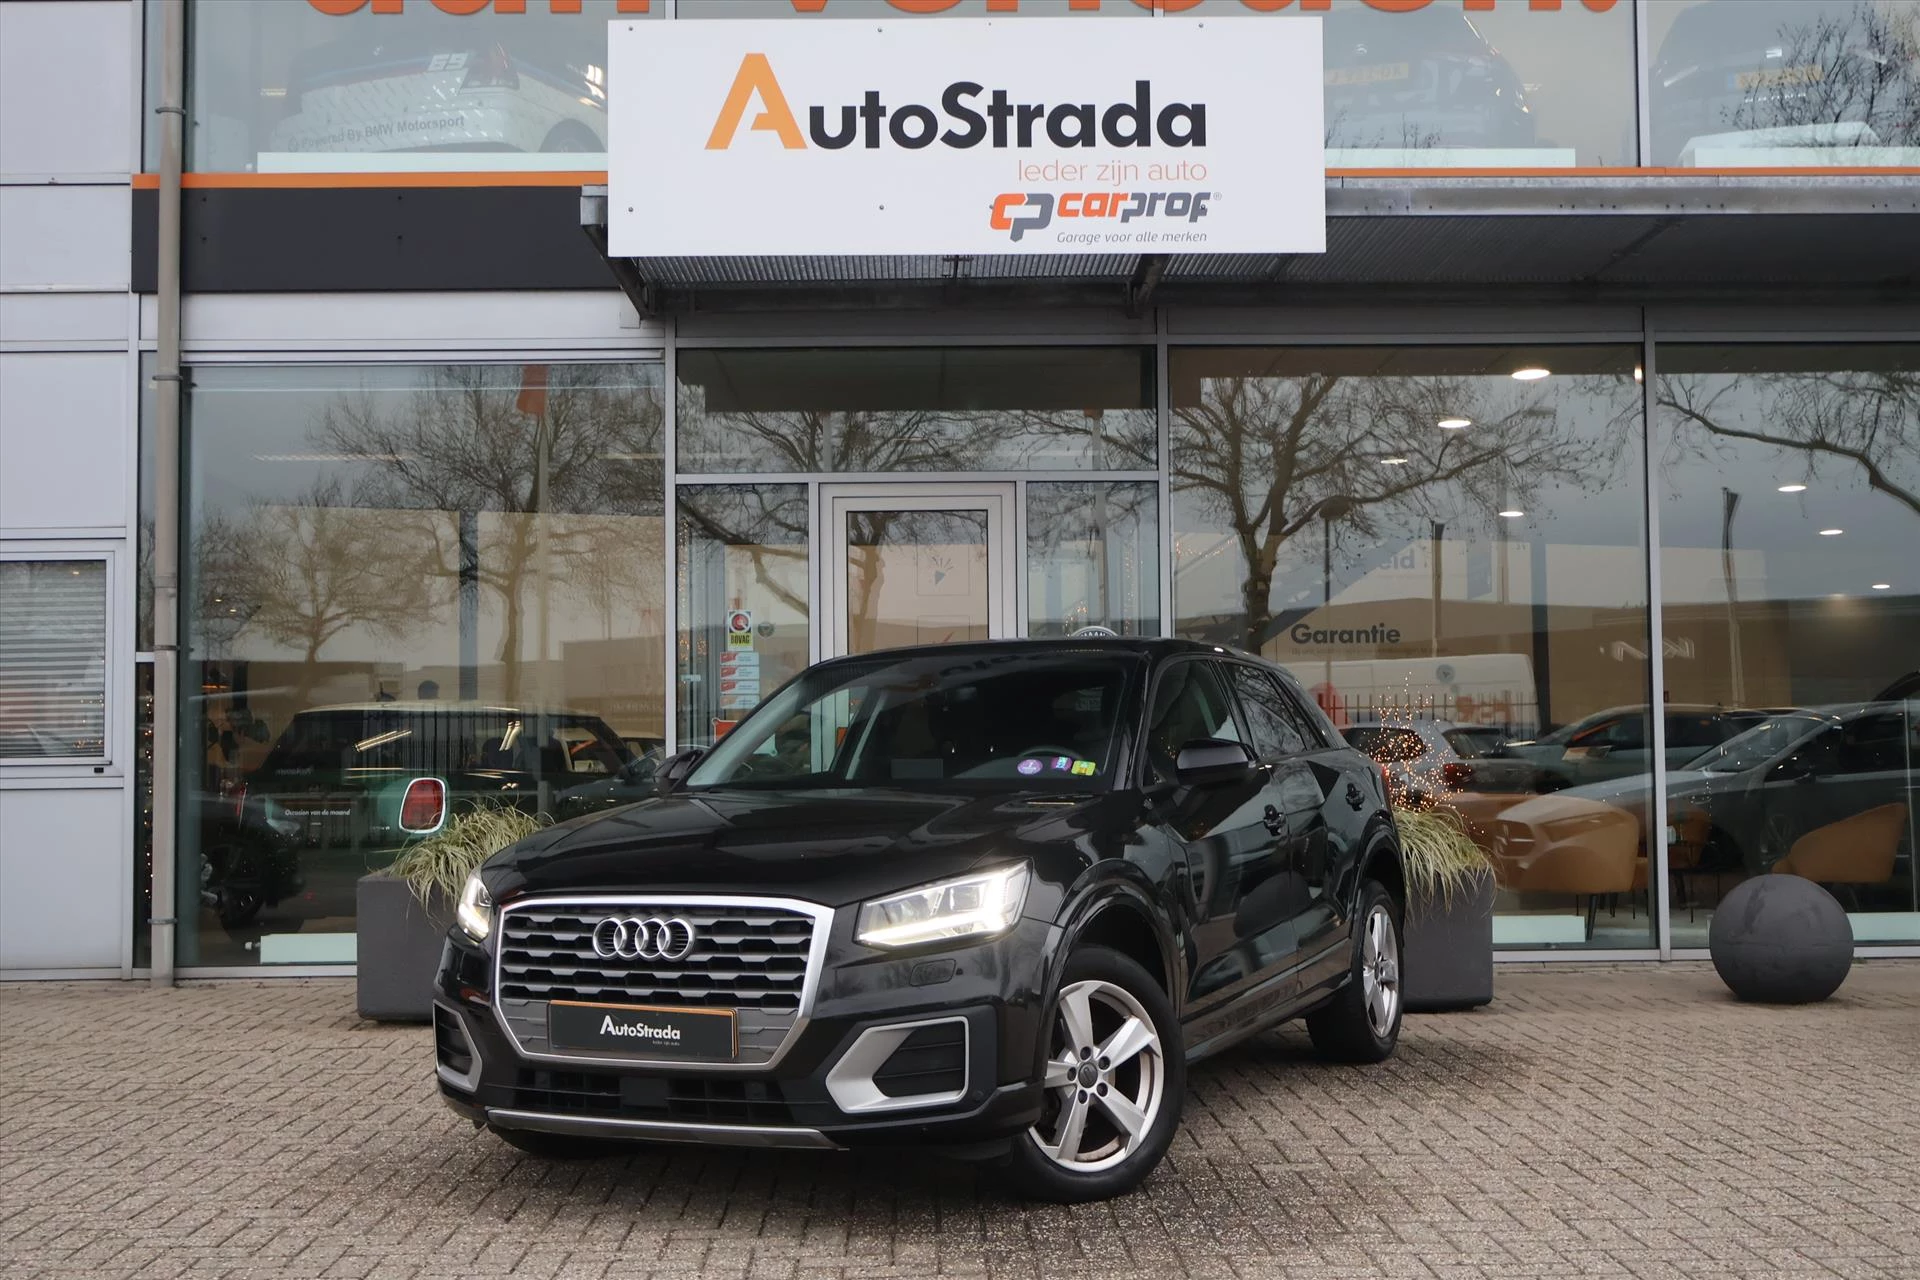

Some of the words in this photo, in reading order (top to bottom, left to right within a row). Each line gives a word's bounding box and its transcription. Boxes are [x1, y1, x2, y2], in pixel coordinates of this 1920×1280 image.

[704, 53, 1207, 150] AutoStrada
[347, 129, 361, 143] By
[365, 122, 394, 137] BMW
[397, 115, 465, 133] Motorsport
[1018, 159, 1088, 182] Ieder
[1096, 159, 1139, 187] zijn
[1148, 162, 1207, 182] auto
[1057, 231, 1101, 246] Garage
[1105, 233, 1132, 243] voor
[1136, 231, 1158, 242] alle
[1162, 231, 1208, 242] merken
[731, 634, 750, 645] BOVAG
[1290, 622, 1401, 644] Garantie
[321, 808, 330, 817] de
[600, 1014, 681, 1040] AutoStrada
